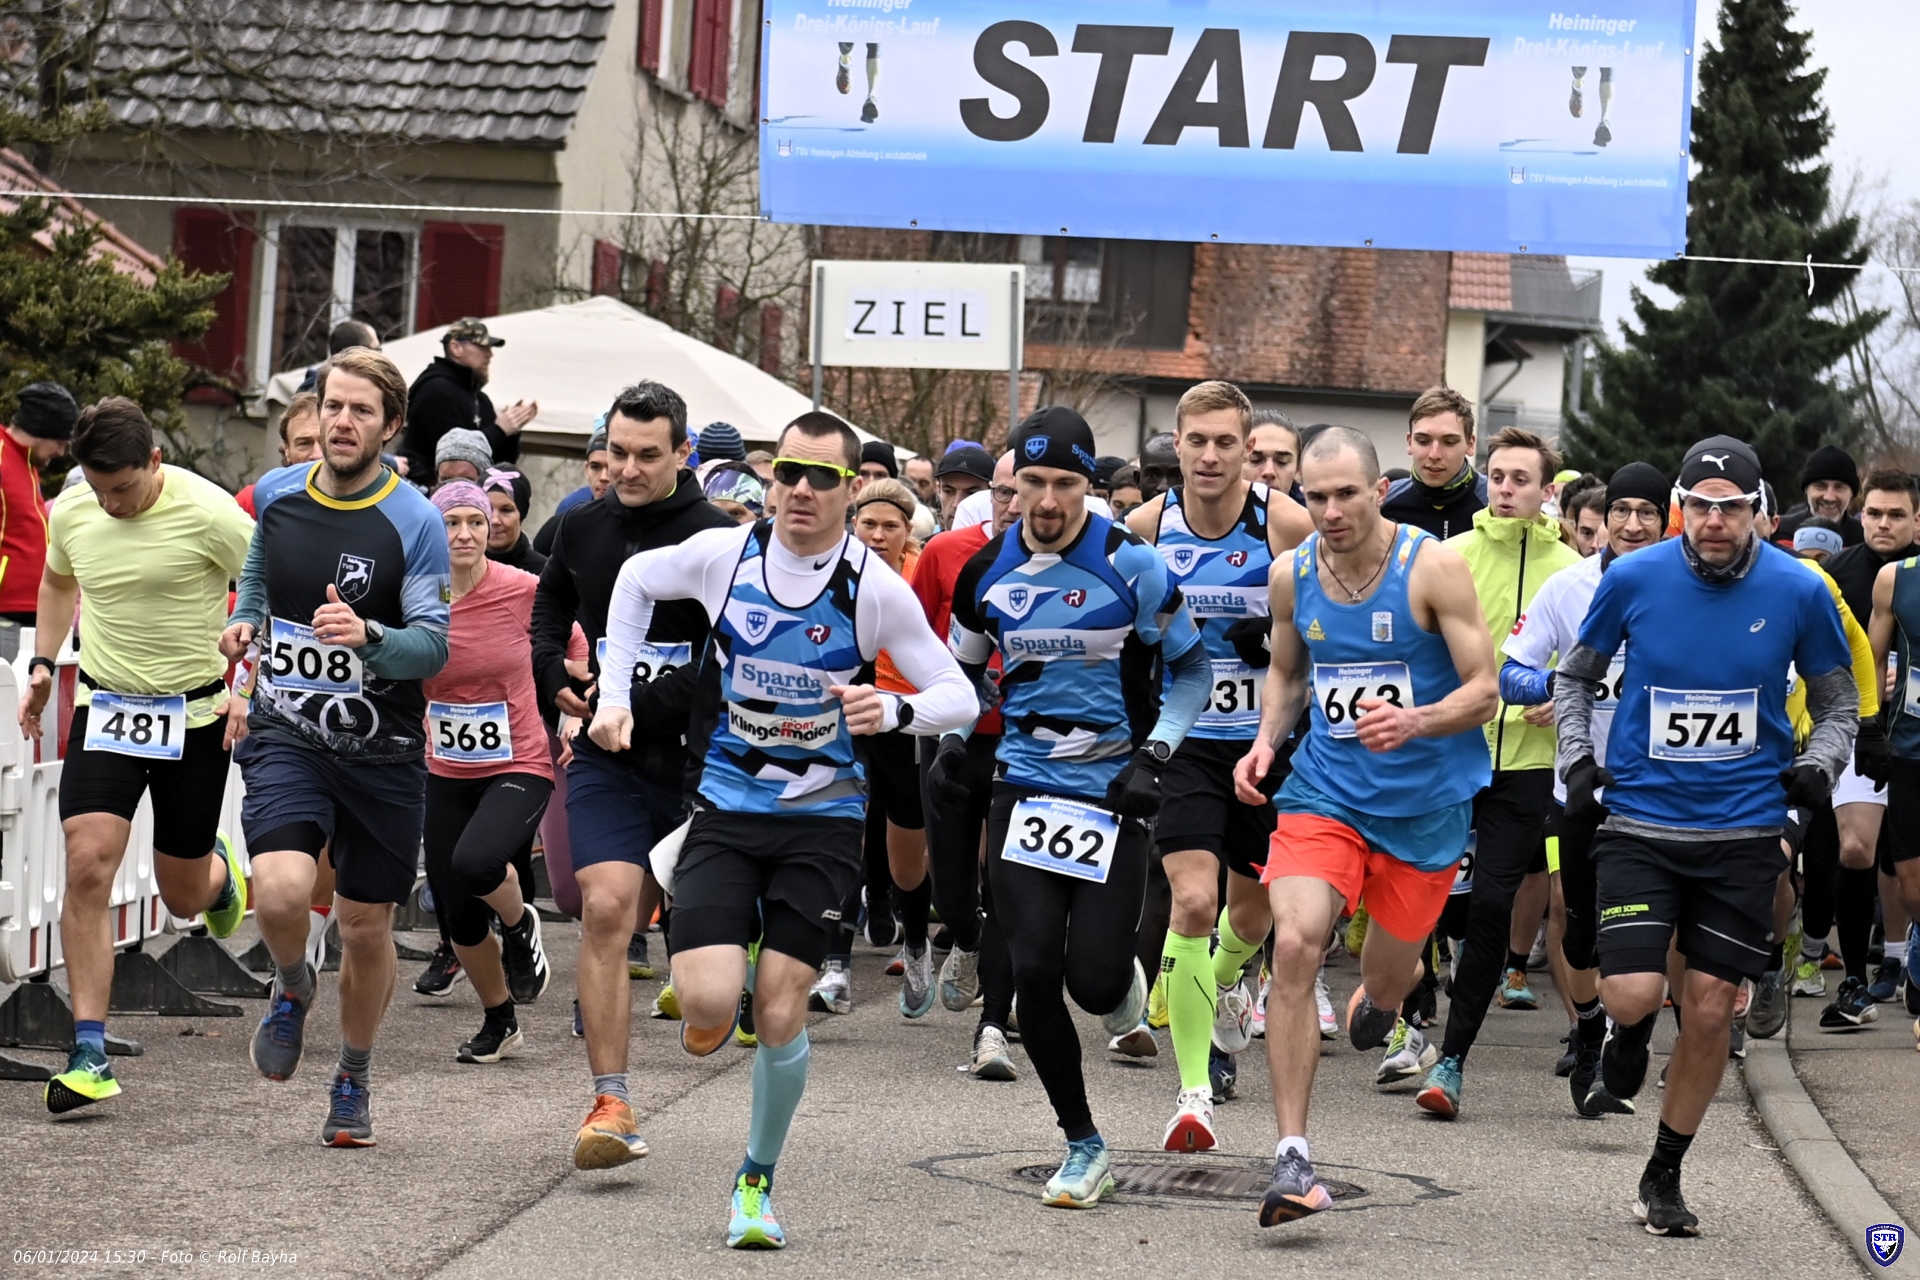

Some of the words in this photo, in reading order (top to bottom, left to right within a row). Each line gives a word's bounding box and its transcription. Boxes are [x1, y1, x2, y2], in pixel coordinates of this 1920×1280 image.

[794, 13, 941, 37] Drei-Königs-Lauf
[1549, 12, 1637, 36] Heininger
[1514, 36, 1666, 61] Drei-Königs-Lauf
[960, 20, 1490, 155] START
[853, 300, 980, 337] ZIEL
[342, 563, 354, 571] TVB
[1010, 589, 1027, 598] STR
[1183, 592, 1247, 609] parda
[748, 613, 766, 622] STR
[294, 627, 315, 637] Heini
[1010, 635, 1086, 654] Sparda
[272, 641, 352, 683] 508
[1338, 667, 1373, 676] Heininger
[742, 663, 822, 688] Sparda
[771, 687, 799, 699] Team
[1202, 679, 1255, 714] 31
[1325, 684, 1404, 724] 663
[101, 712, 170, 746] 481
[440, 721, 502, 752] 568
[782, 720, 816, 731] SPORT
[1665, 712, 1743, 748] 574
[1020, 816, 1104, 868] 362
